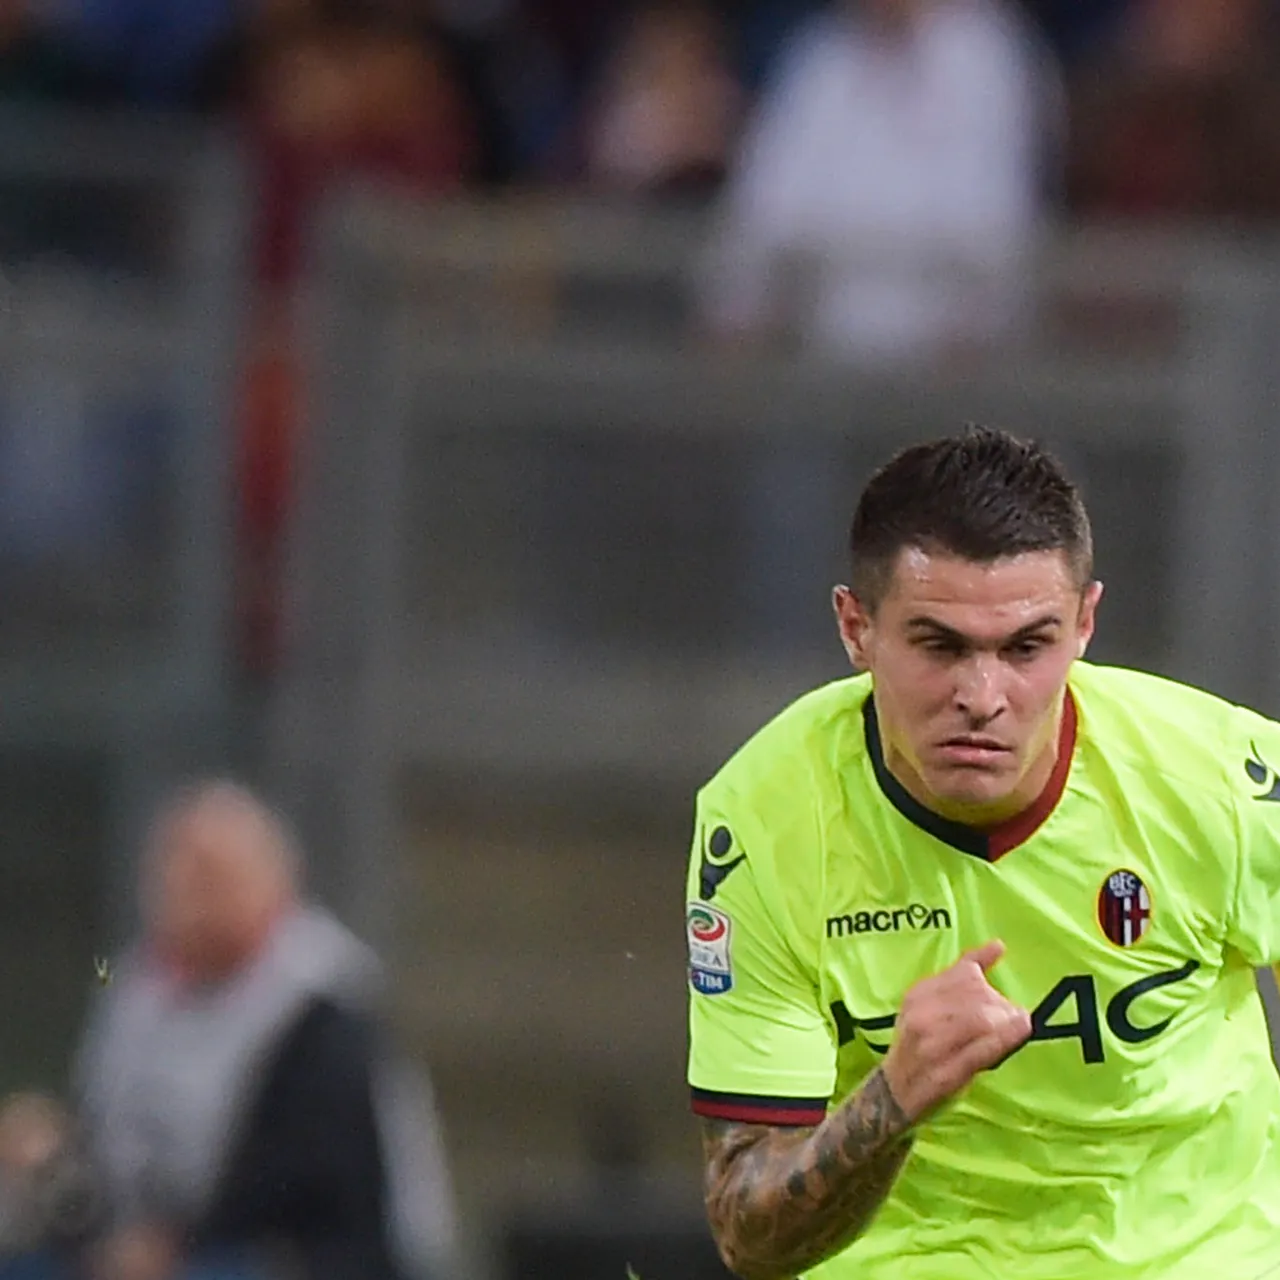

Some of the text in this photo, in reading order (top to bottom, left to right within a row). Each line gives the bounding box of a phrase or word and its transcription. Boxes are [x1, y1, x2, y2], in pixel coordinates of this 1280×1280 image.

[826, 903, 952, 938] macron
[700, 971, 723, 989] TIM
[829, 959, 1202, 1064] AC
